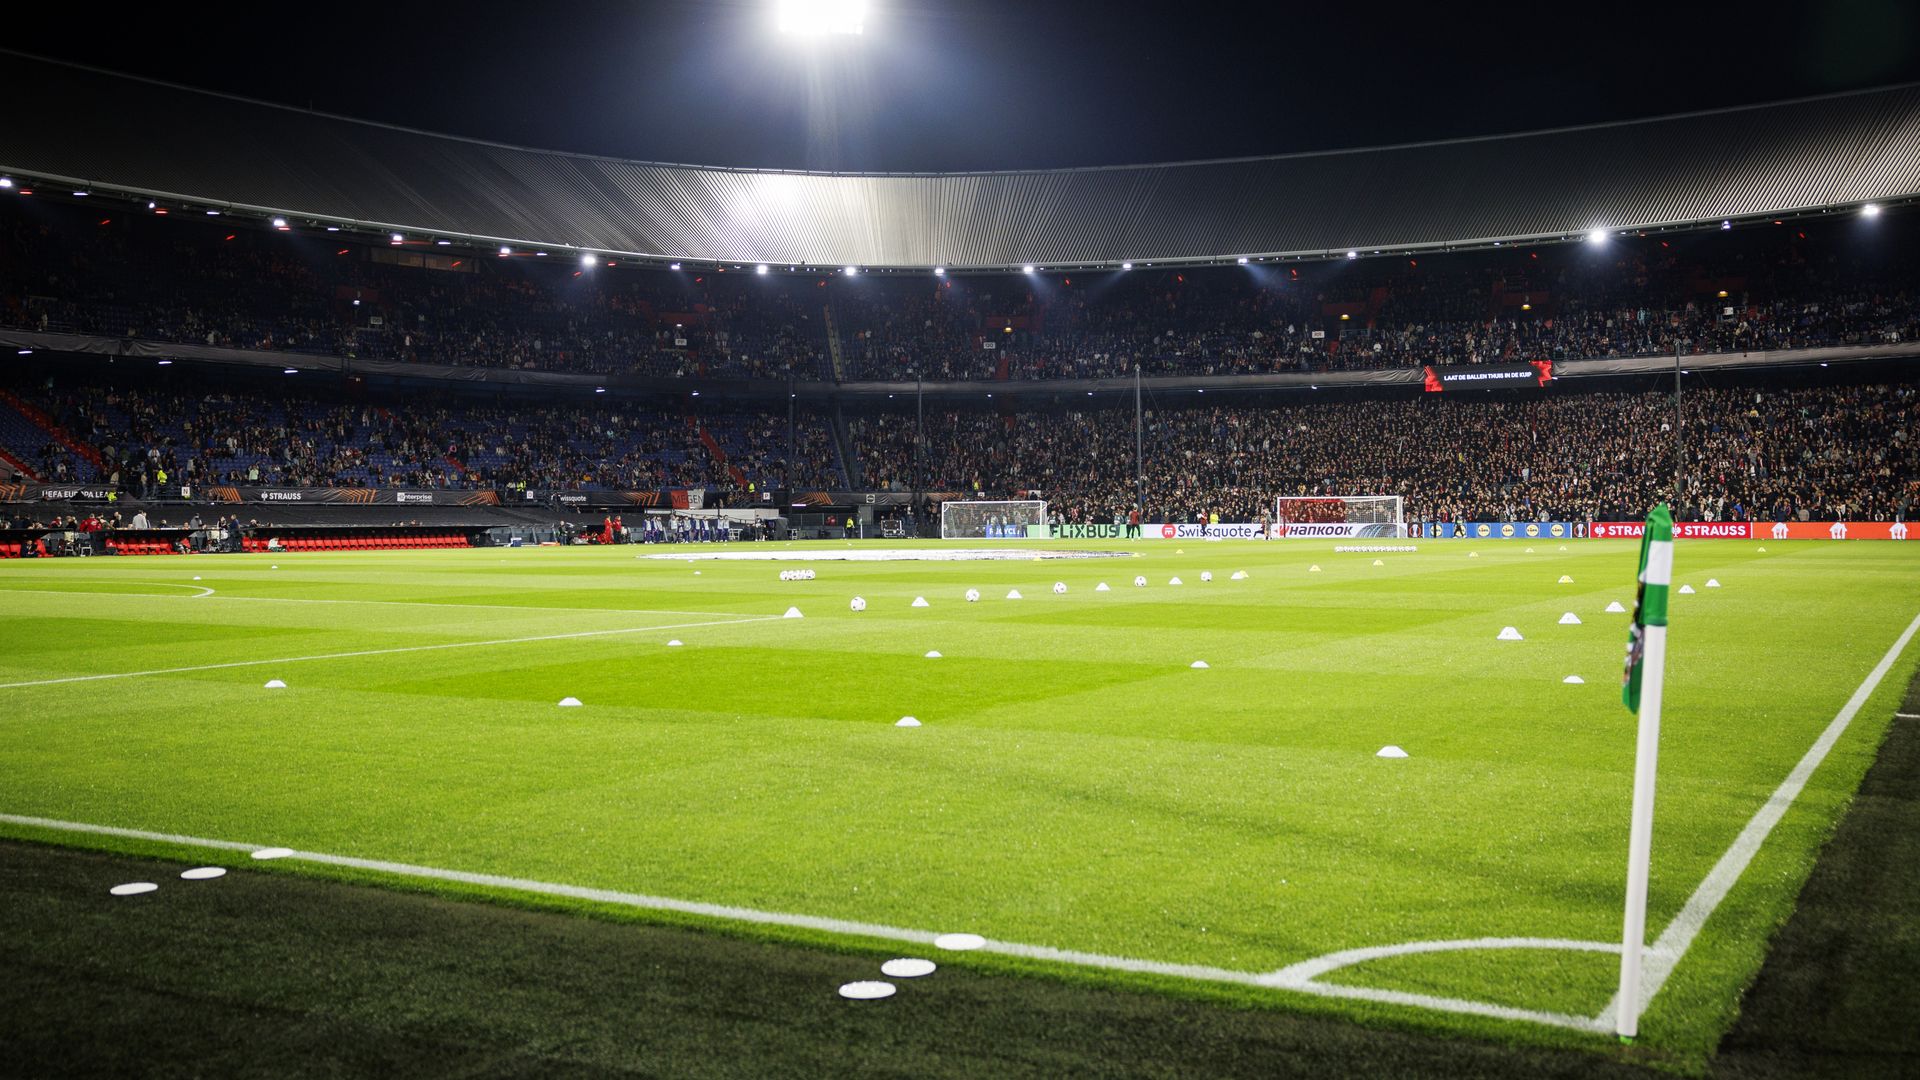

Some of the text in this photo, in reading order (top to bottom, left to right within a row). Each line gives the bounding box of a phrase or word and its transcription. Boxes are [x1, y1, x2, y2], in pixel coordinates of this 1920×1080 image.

[42, 490, 63, 498] UEFA
[64, 490, 94, 498] EURPA
[269, 492, 301, 500] STRAUSS
[1178, 525, 1251, 538] Swissquote
[1608, 525, 1645, 536] STRA
[1684, 525, 1746, 536] STRAUSS
